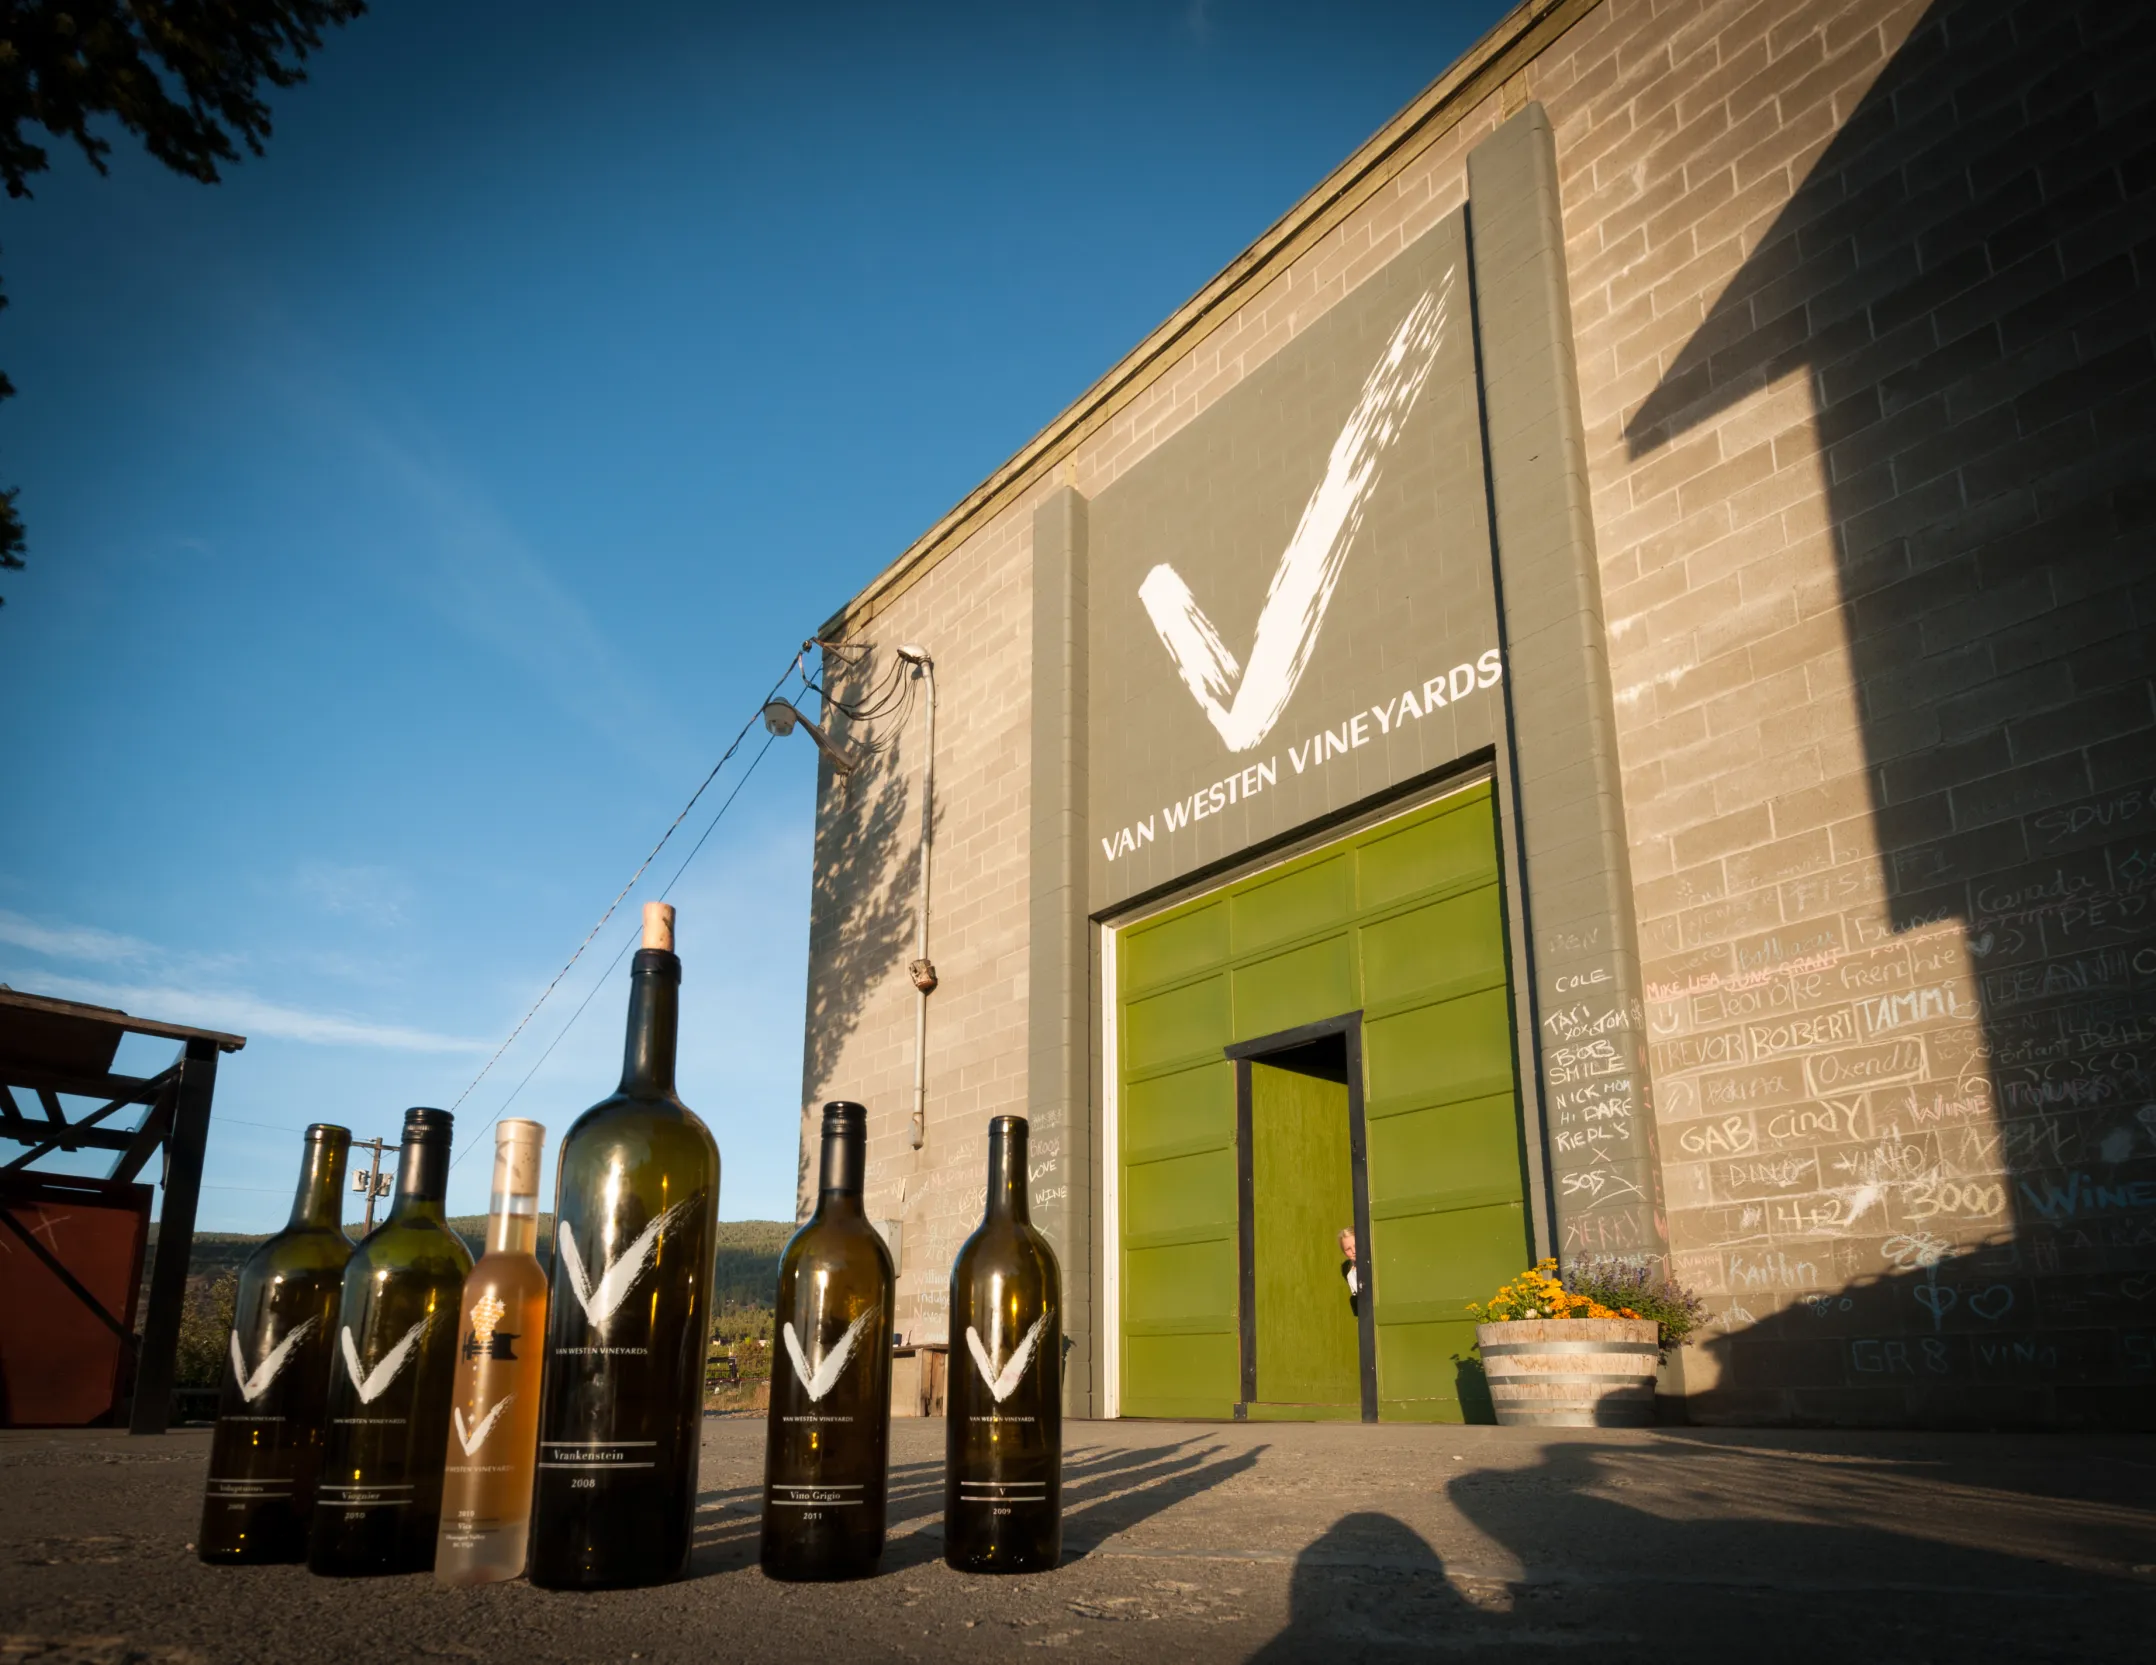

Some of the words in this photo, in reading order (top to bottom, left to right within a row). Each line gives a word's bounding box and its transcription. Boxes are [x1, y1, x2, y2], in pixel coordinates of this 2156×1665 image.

[1102, 814, 1155, 861] VAN
[1163, 756, 1277, 832] WESTEN
[1288, 648, 1503, 774] VINEYARDS
[1548, 1055, 1627, 1086] SMILE
[1555, 1083, 1602, 1110] NICK
[1027, 1159, 1057, 1184] LOVE
[1035, 1185, 1067, 1205] WINE
[568, 1347, 598, 1355] WESTEN
[599, 1346, 649, 1355] VINEYARDS
[794, 1415, 818, 1423] WESTEN
[553, 1449, 625, 1461] Vrankenstein
[571, 1479, 597, 1489] 2008
[790, 1491, 810, 1500] Vino
[812, 1491, 841, 1502] Grigio
[999, 1487, 1007, 1496] V
[803, 1512, 823, 1520] 2011
